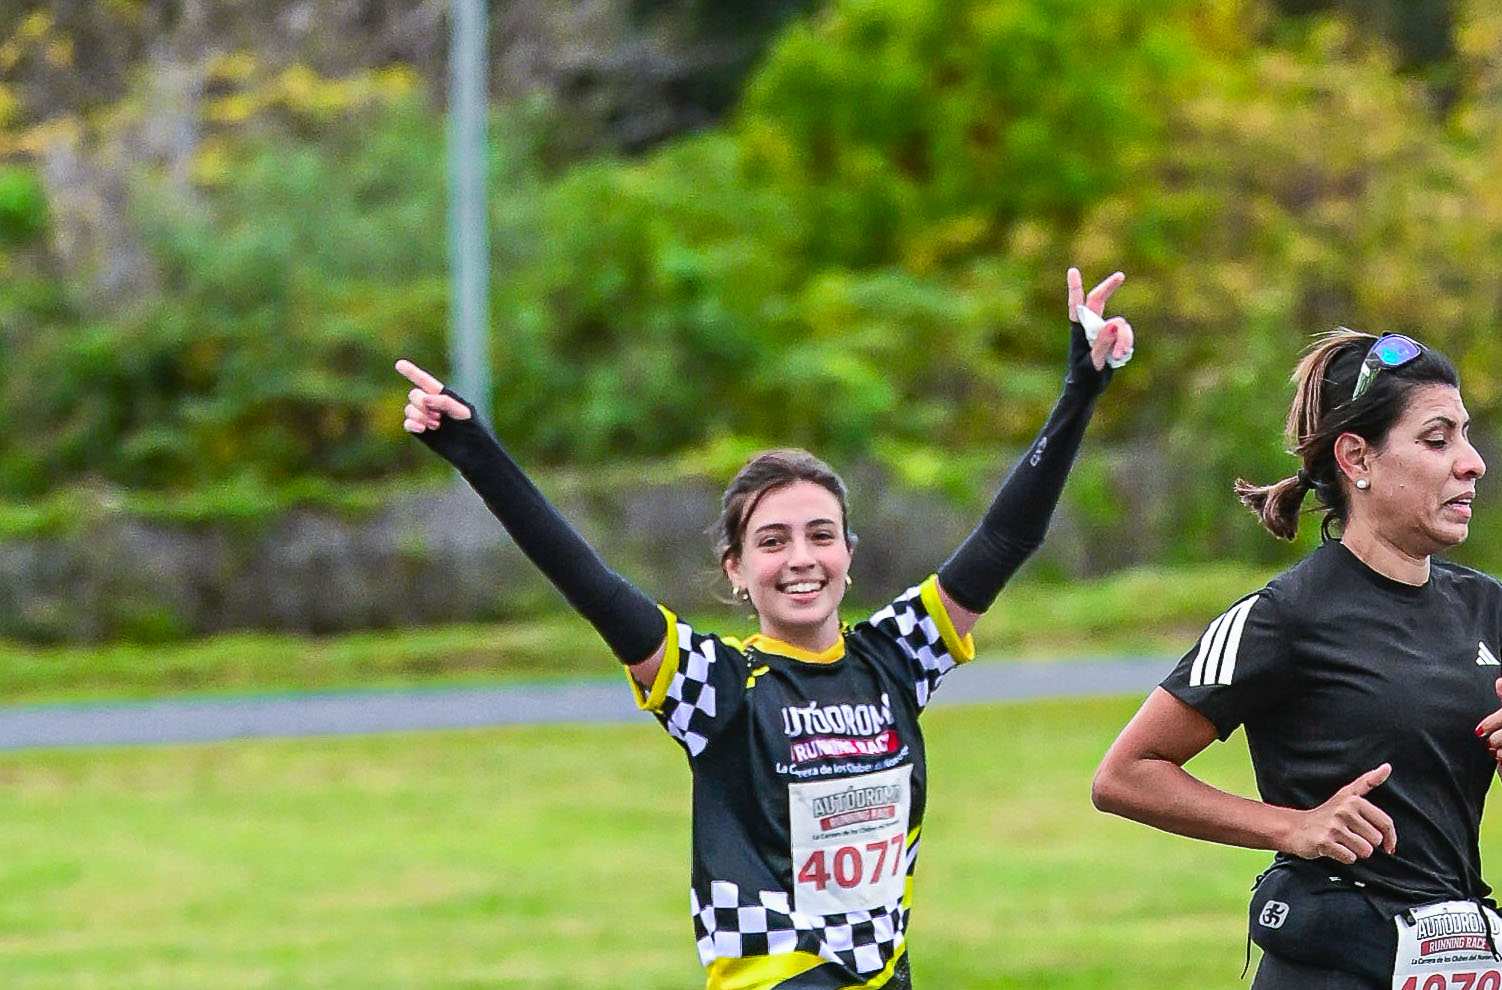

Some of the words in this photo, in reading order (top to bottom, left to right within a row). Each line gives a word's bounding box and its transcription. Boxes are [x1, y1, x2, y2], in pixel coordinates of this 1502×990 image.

[781, 693, 894, 738] UTÓDROM
[856, 733, 889, 754] RAC
[776, 762, 788, 774] La
[820, 765, 832, 775] de
[813, 785, 900, 818] AUTÓDROM
[798, 833, 904, 891] 4077
[1429, 936, 1465, 952] RUNNING
[1466, 936, 1486, 950] RACE
